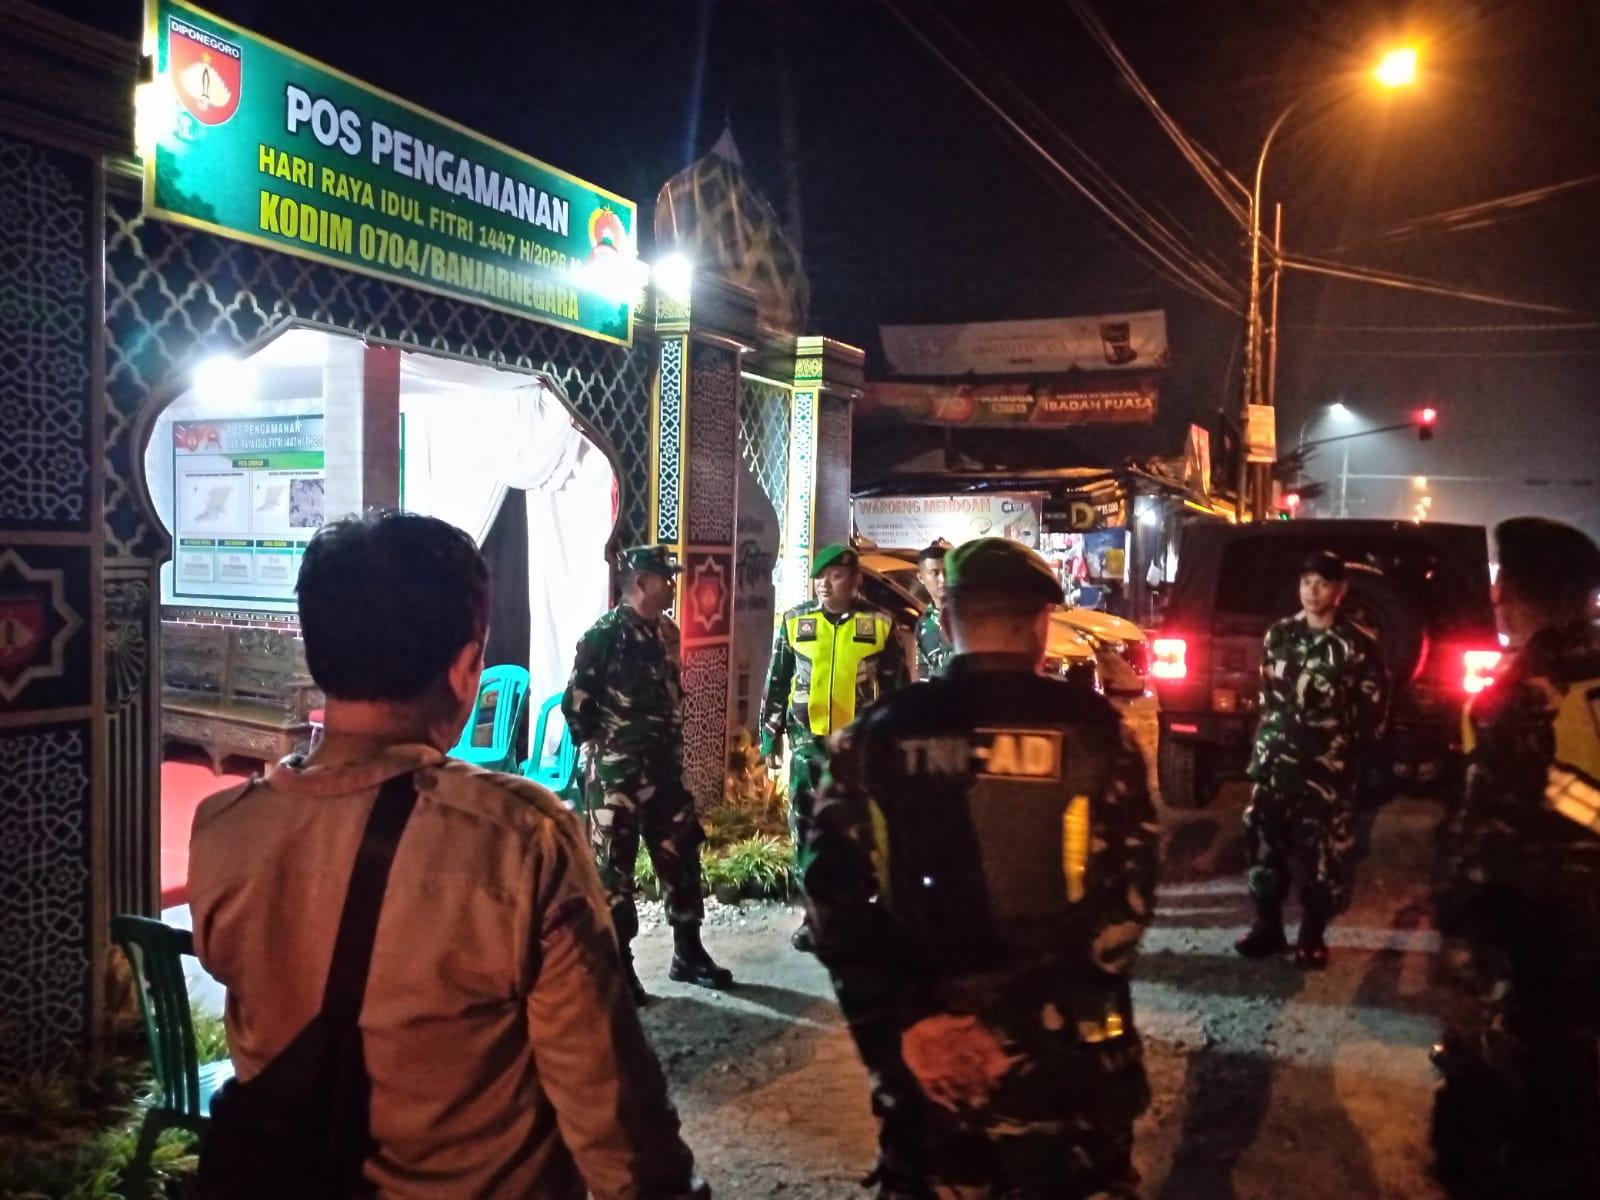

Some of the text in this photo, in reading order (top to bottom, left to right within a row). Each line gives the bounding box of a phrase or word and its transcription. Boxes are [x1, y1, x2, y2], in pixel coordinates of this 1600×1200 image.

[171, 21, 240, 58] DIPONEGORO
[286, 85, 569, 237] POS PENGAMANAN
[259, 144, 314, 188] HARI
[321, 166, 375, 209] RAYA
[380, 188, 424, 226] IDUL
[430, 206, 474, 242] FITRI
[479, 225, 515, 256] 1447
[260, 190, 579, 321] KODIM 0704/BANJARNEGARA
[1044, 398, 1153, 412] IBADAH PUASA
[858, 499, 921, 514] WAROENG
[924, 498, 992, 513] MENDOAN
